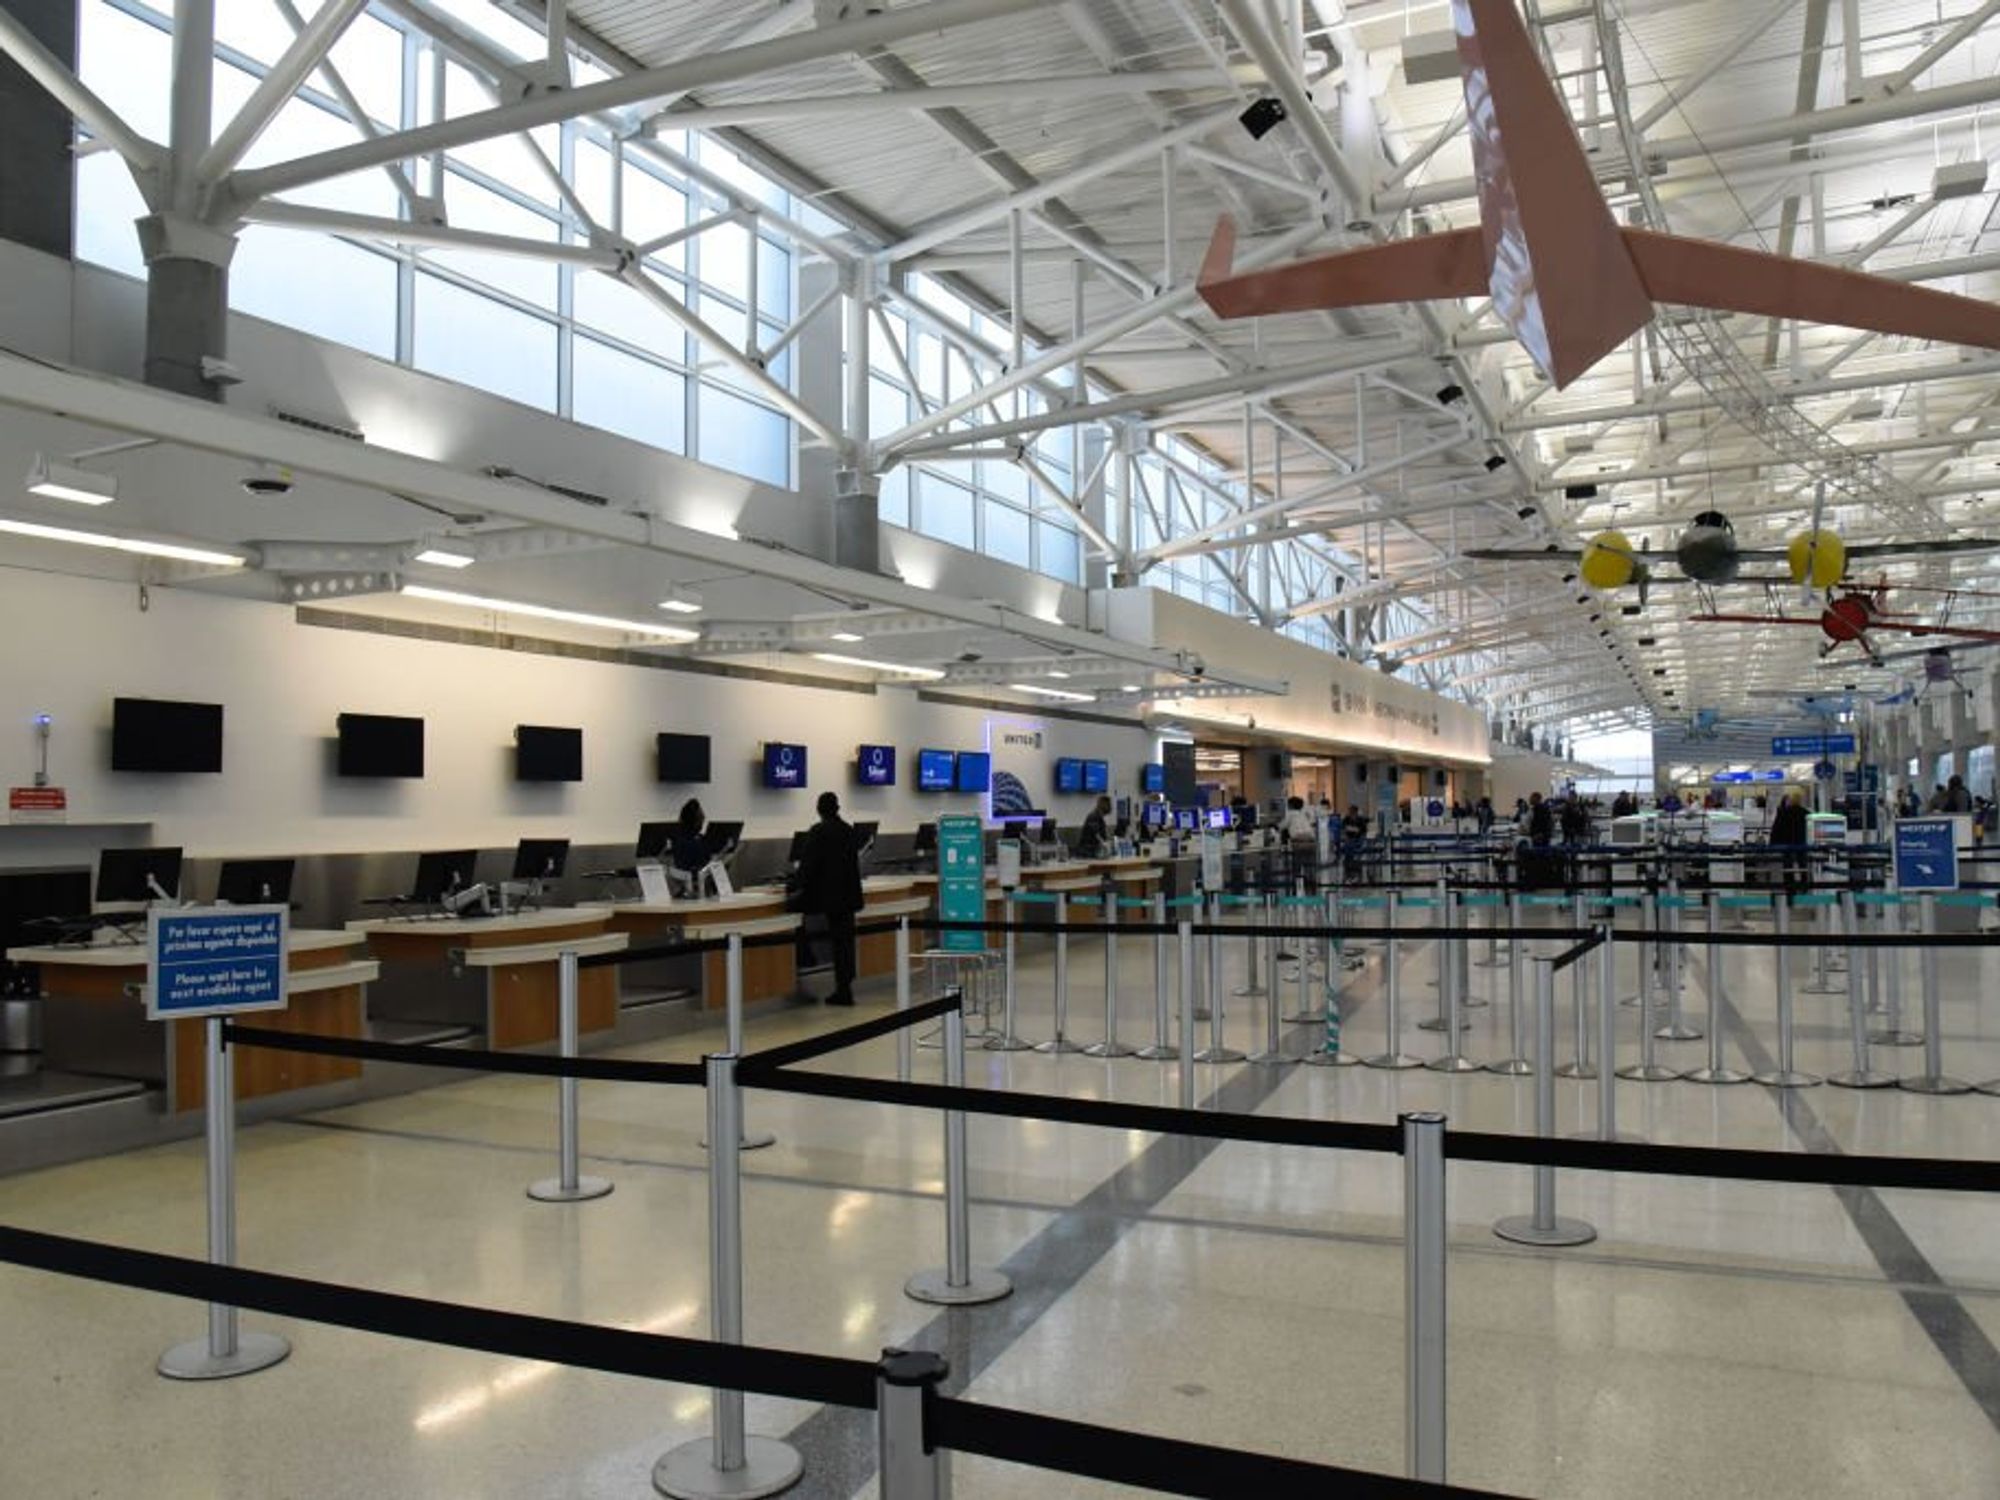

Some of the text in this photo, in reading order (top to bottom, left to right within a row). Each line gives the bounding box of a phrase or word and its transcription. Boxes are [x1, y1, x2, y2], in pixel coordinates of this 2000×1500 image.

[1004, 734, 1033, 746] UNITED
[168, 926, 184, 939] Por
[185, 922, 212, 938] favor
[204, 938, 234, 951] agente
[236, 932, 278, 948] disponible
[175, 964, 267, 985] Please wait here for
[170, 980, 271, 1000] next available agent
